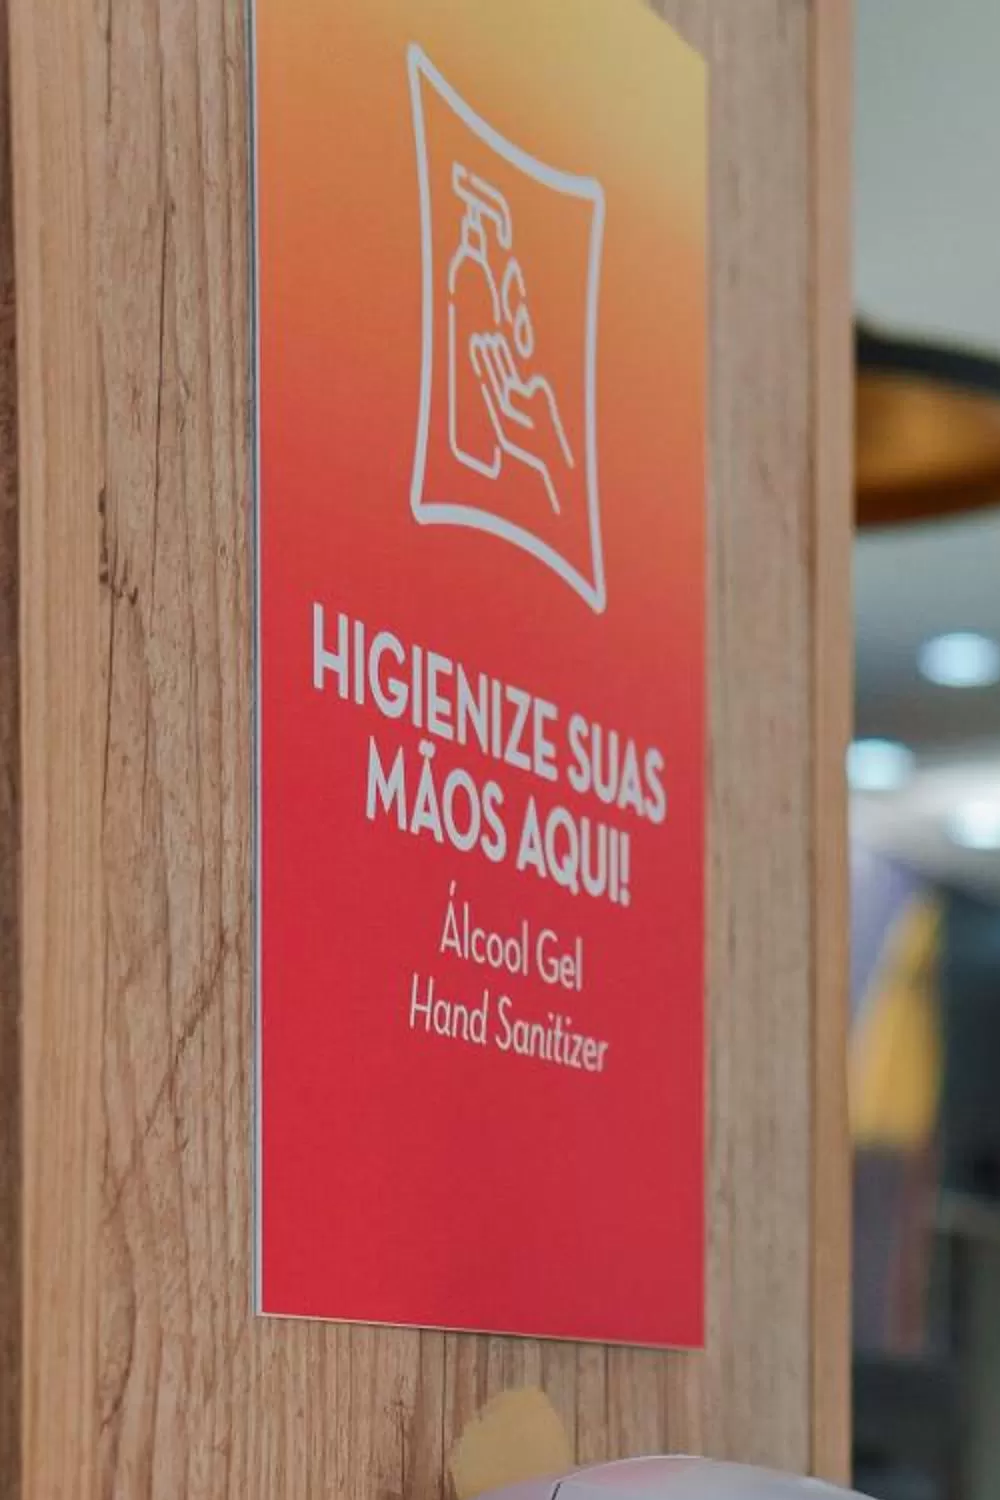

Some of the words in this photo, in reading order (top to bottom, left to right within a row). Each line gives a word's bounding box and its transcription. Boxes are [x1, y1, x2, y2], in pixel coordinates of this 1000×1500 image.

[313, 602, 559, 782] HIGIENIZE
[566, 712, 667, 825] SUAS
[366, 735, 508, 863] MÃOS
[516, 796, 631, 907] AQUI!
[440, 880, 529, 976] Álcool
[535, 928, 584, 992] Gel
[410, 971, 489, 1045] Hand
[496, 994, 609, 1073] Sanitizer
